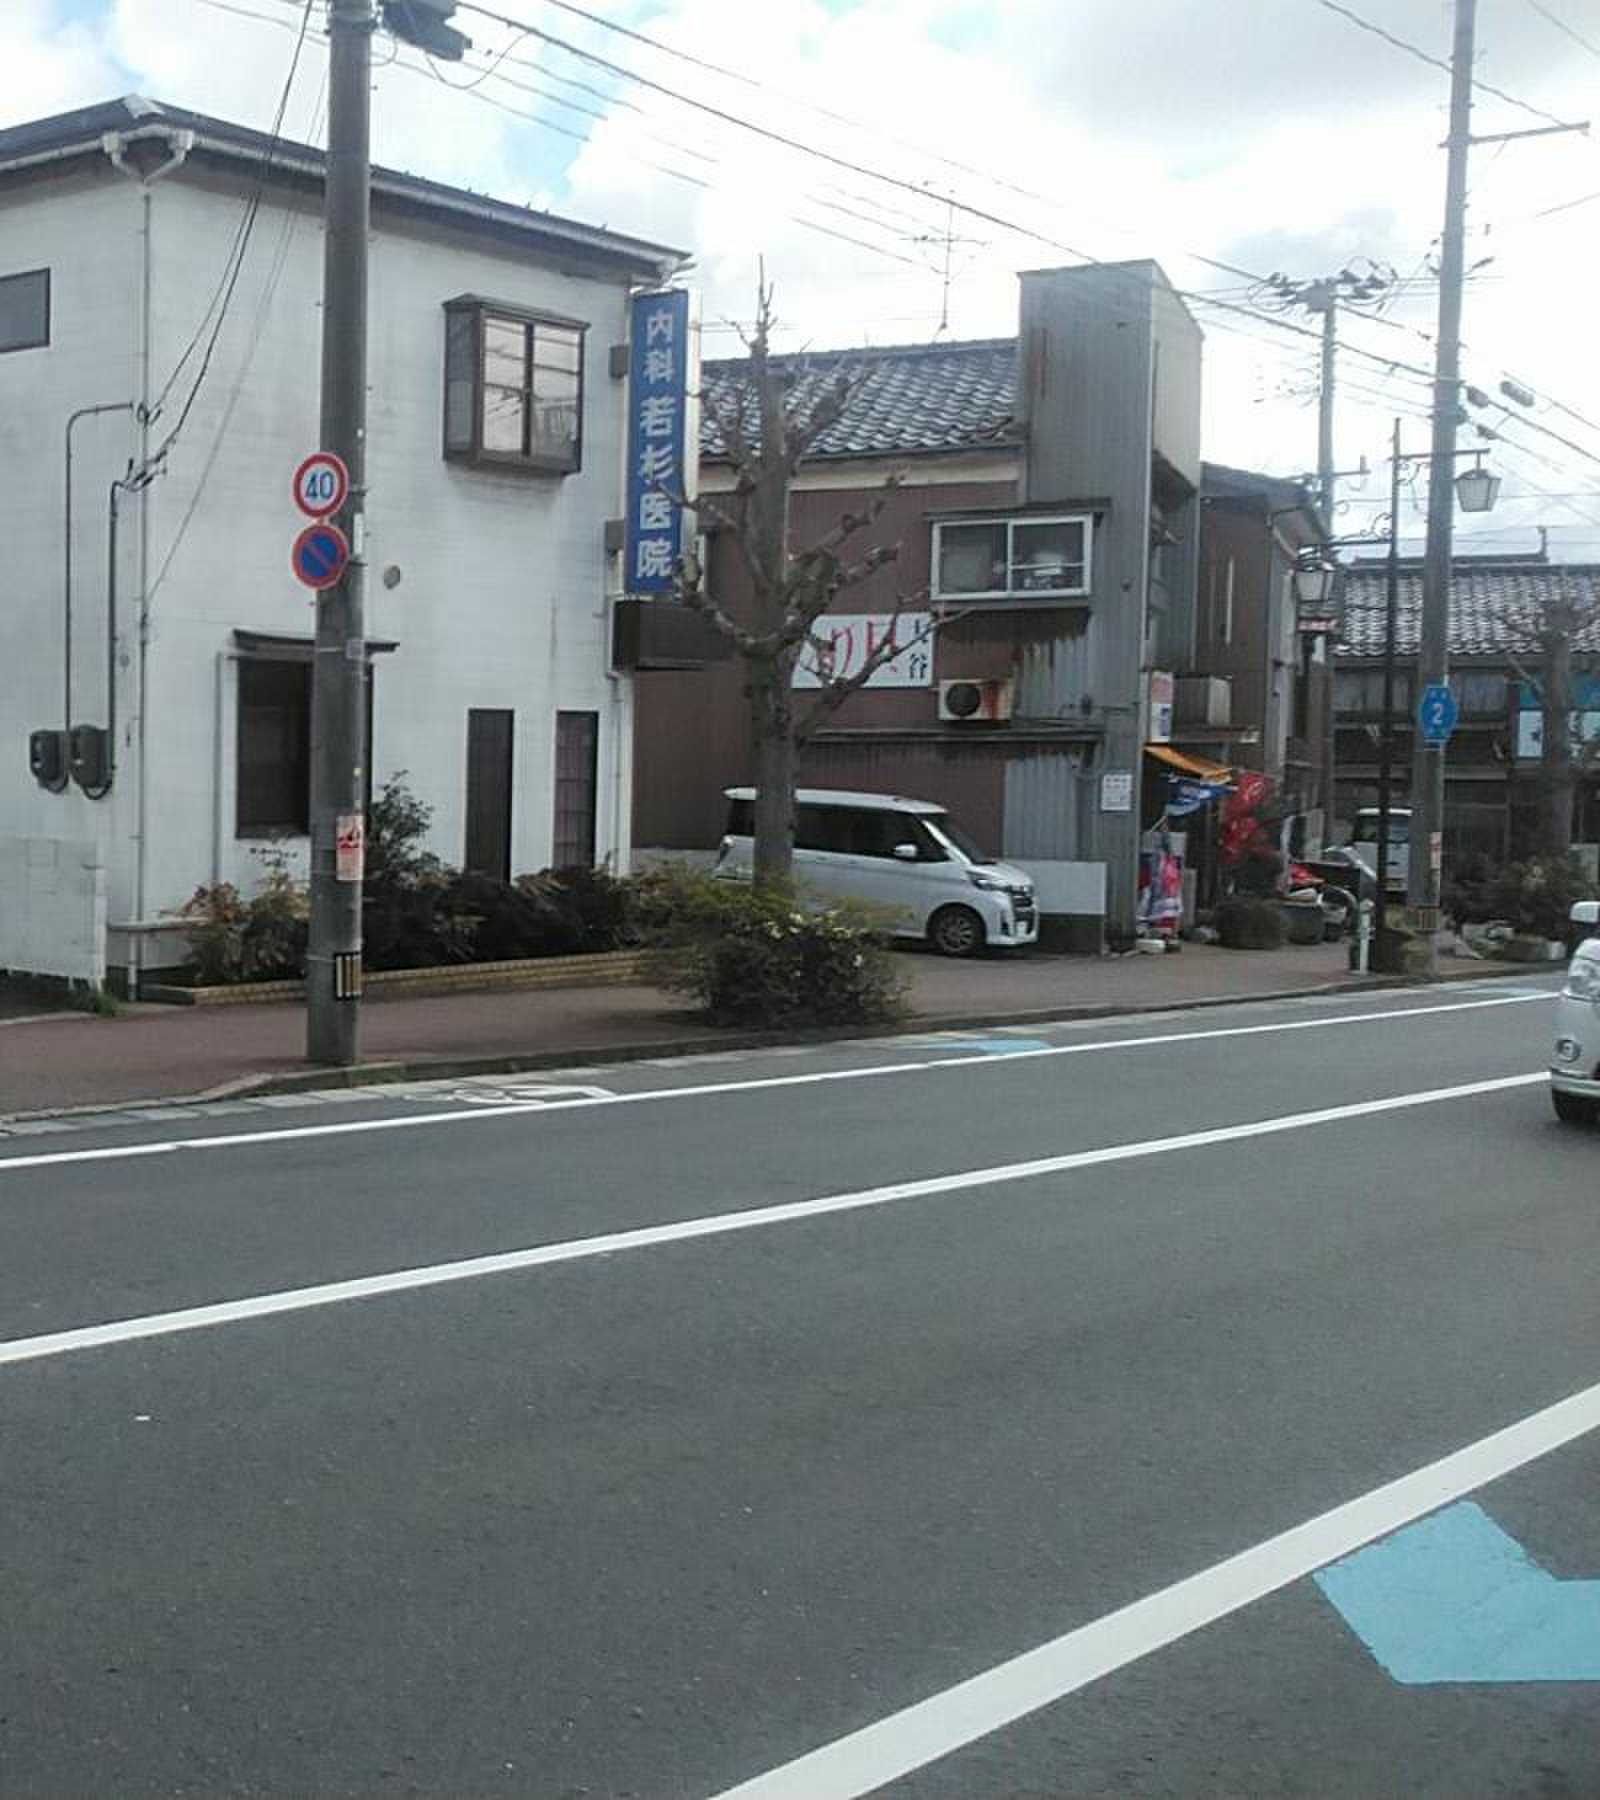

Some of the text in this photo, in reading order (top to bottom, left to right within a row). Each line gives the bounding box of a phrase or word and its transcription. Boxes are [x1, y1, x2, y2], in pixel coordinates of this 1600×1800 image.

[636, 309, 677, 580] 内科若杉医院
[305, 470, 335, 500] 40
[1431, 703, 1445, 725] 2
